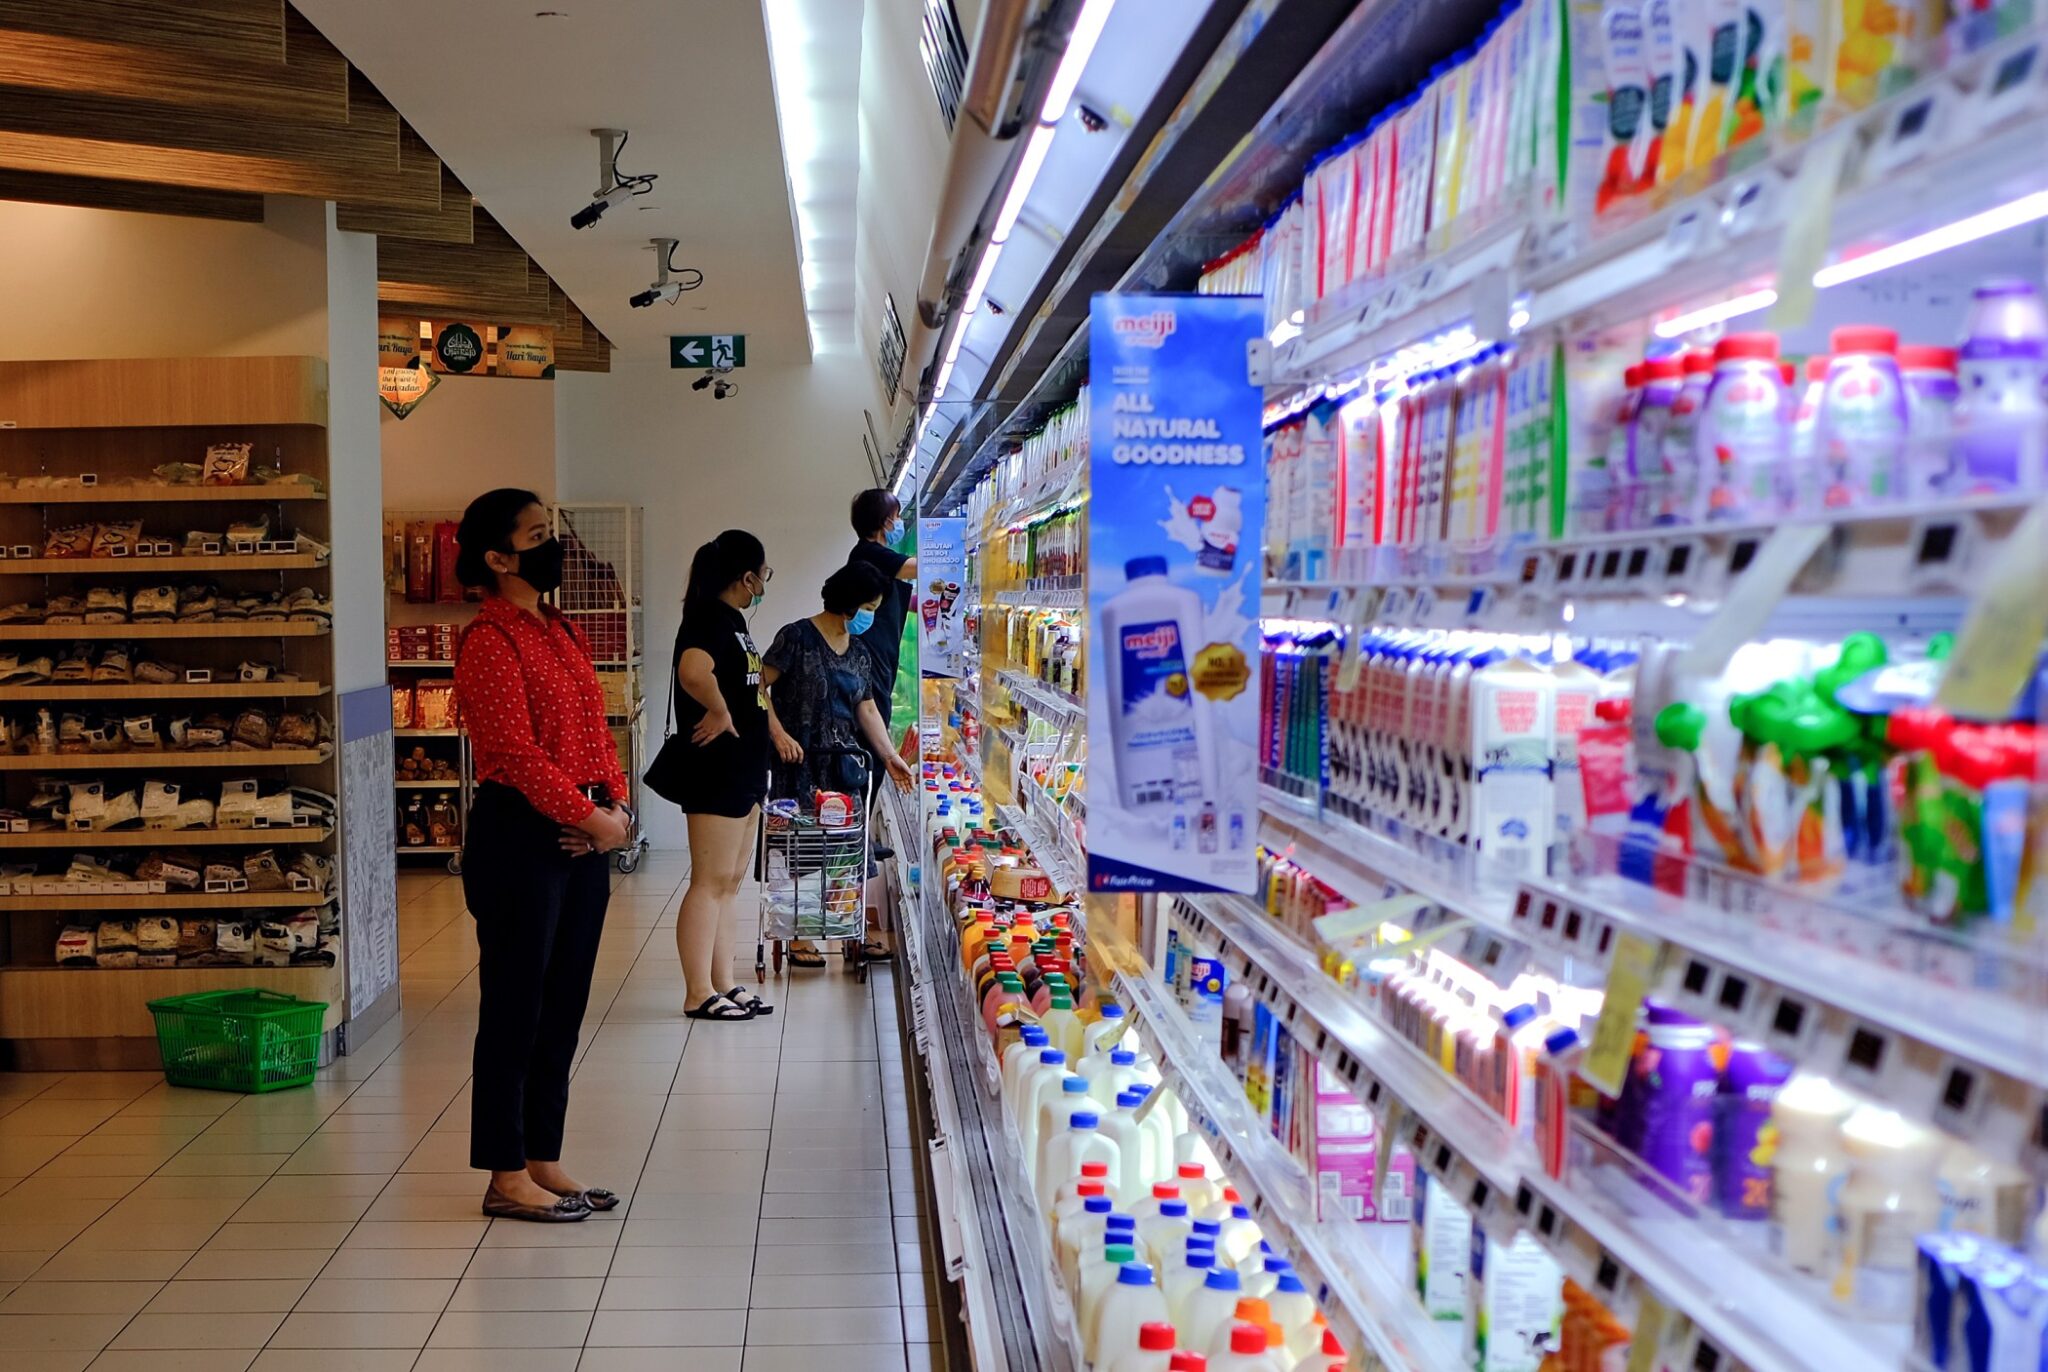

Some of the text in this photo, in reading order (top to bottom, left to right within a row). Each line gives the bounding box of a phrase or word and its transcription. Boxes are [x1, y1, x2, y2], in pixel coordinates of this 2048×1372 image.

[1114, 312, 1176, 336] meiji
[391, 342, 413, 356] Raya
[506, 350, 547, 365] Hari Raya
[1113, 392, 1154, 413] ALL
[1112, 418, 1222, 440] NATURAL
[1112, 444, 1245, 466] GOODNESS
[1125, 626, 1176, 650] meiji
[1110, 874, 1155, 887] FairPrice
